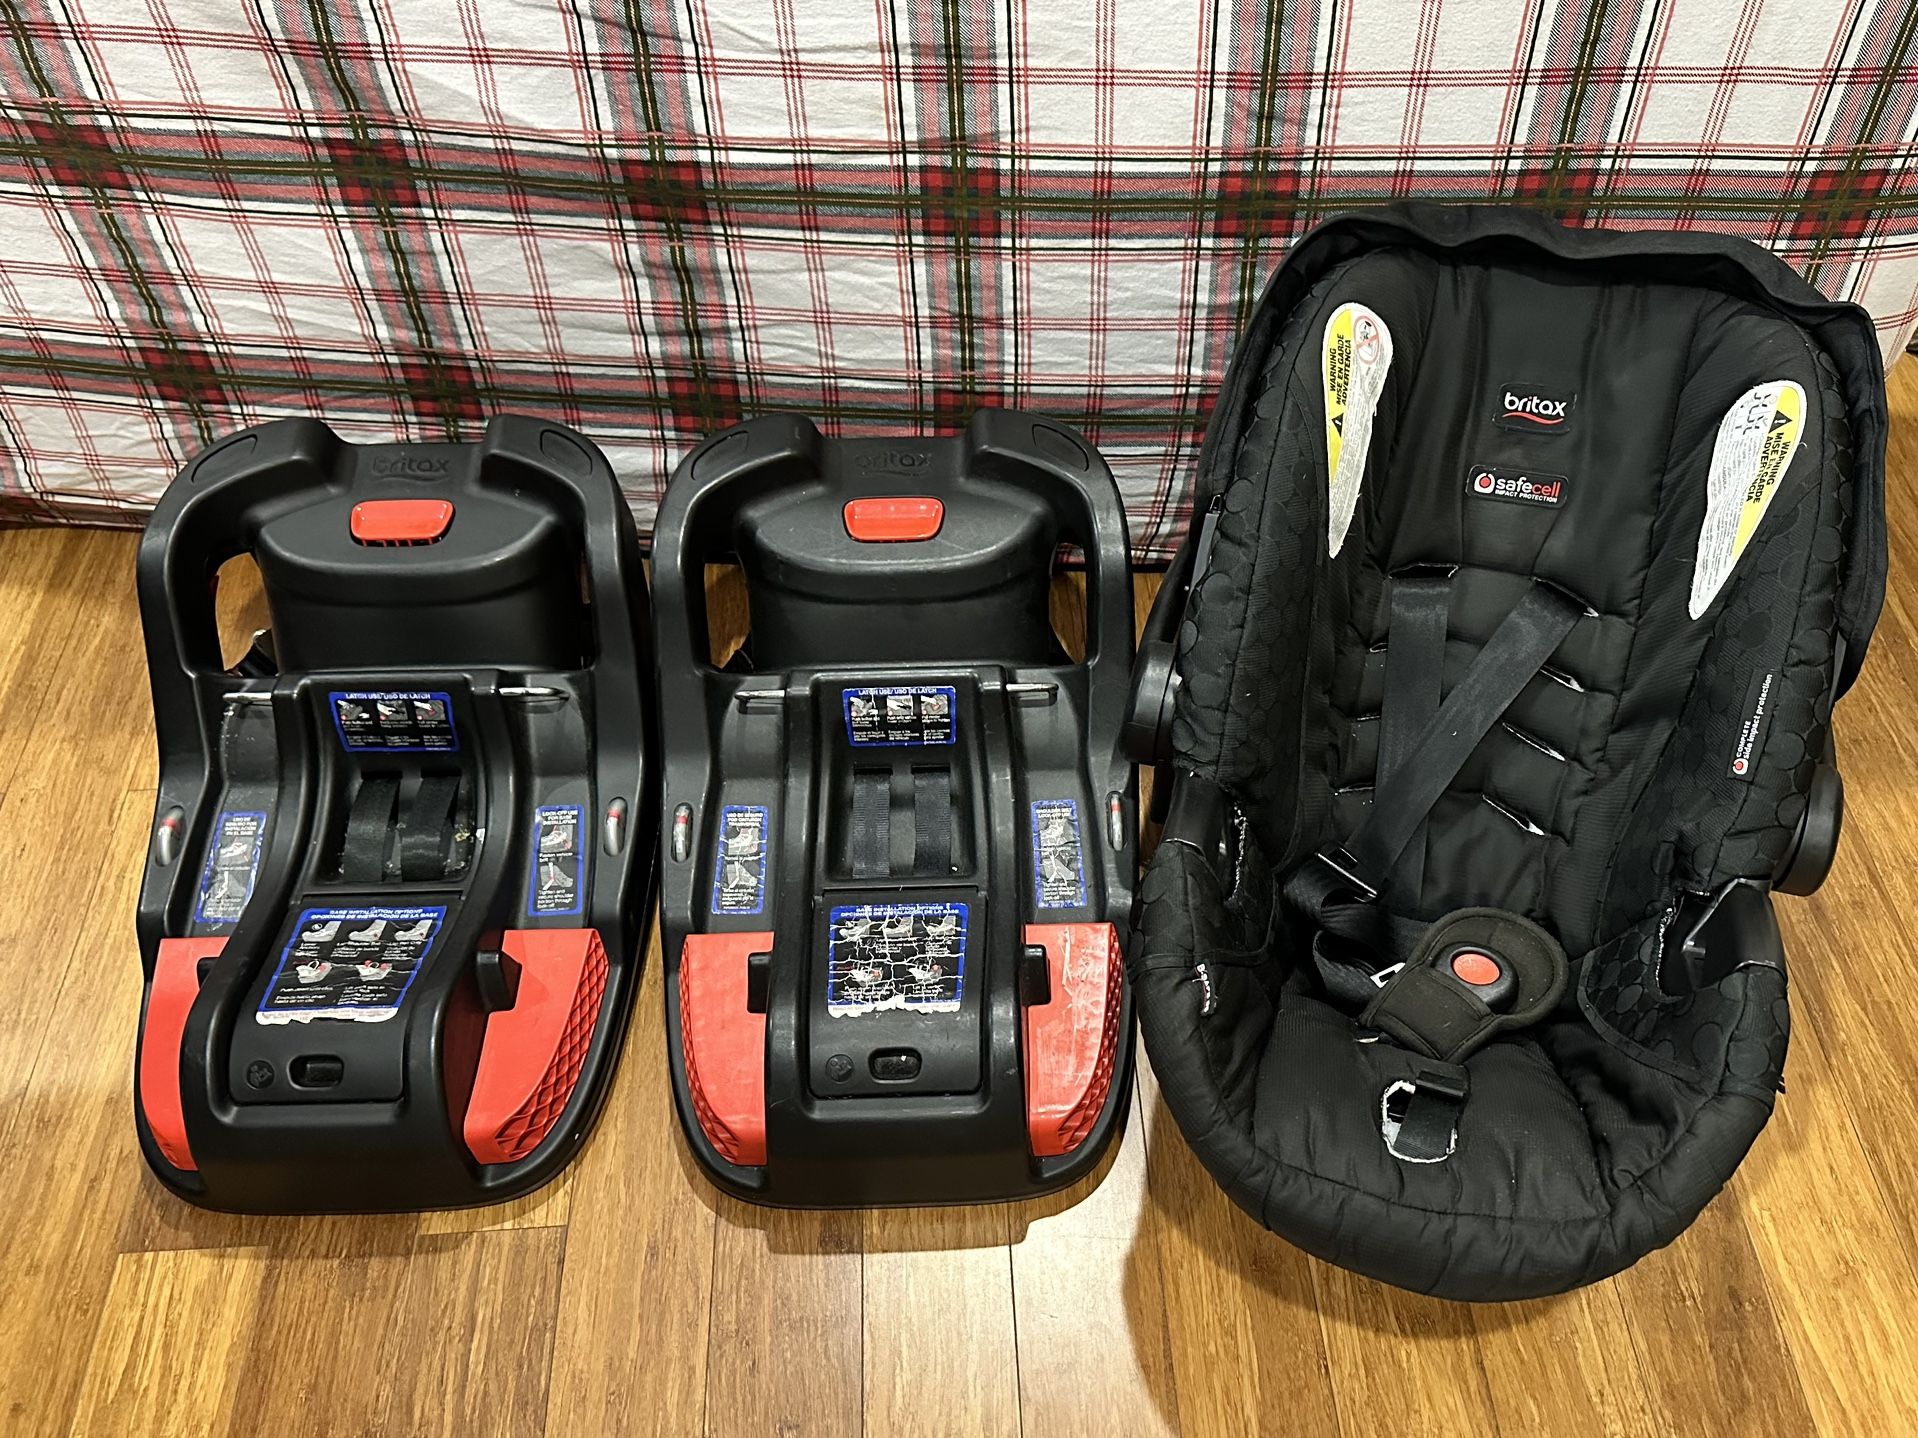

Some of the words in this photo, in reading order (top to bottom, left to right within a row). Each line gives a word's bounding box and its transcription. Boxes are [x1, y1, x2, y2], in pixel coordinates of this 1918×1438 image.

[1337, 333, 1345, 363] GARDE
[1329, 348, 1337, 392] WARNING
[1337, 366, 1344, 381] EN
[1341, 339, 1352, 406] ADVERTENCIA
[1504, 391, 1567, 417] britax
[1770, 432, 1785, 456] MISE
[1495, 489, 1518, 497] IMPACT
[1519, 490, 1558, 503] PROTECTION
[1496, 476, 1561, 497] safecell
[1752, 471, 1769, 504] GARDE
[1756, 674, 1773, 715] protection
[1736, 720, 1752, 758] COMPLETE
[1747, 715, 1761, 742] impact
[1744, 743, 1753, 759] side
